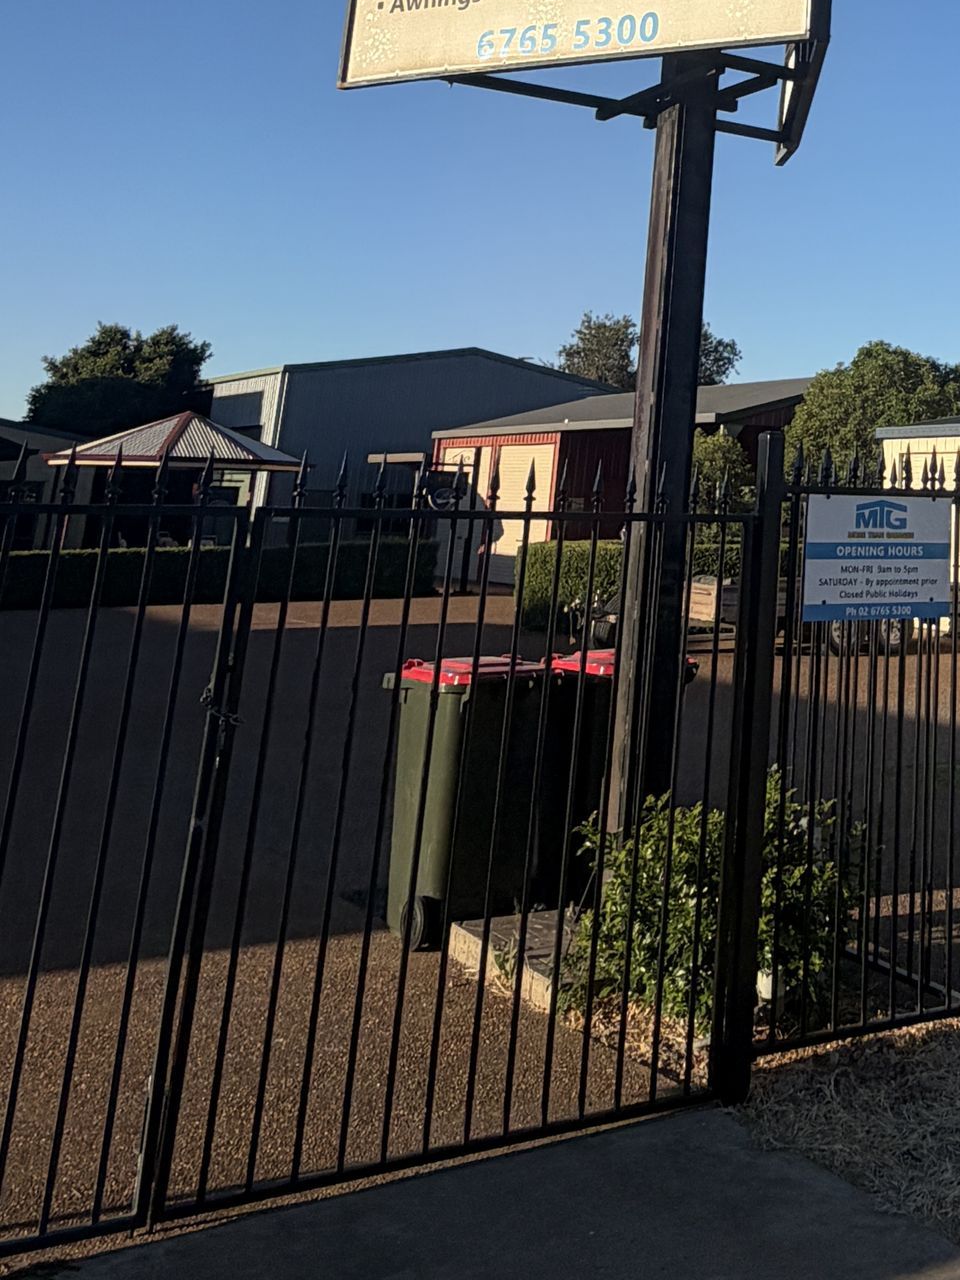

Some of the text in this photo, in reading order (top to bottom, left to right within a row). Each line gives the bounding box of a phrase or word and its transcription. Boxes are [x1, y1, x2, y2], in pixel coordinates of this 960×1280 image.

[477, 12, 660, 60] 6765 5300
[855, 500, 907, 530] MTG
[836, 545, 923, 557] OPENING HOURS
[840, 565, 873, 574] MON-FRI
[894, 565, 902, 573] to
[903, 565, 918, 575] 5pm
[819, 578, 858, 587] SATURDAY
[865, 578, 873, 587] By
[876, 578, 919, 587] appointment
[921, 578, 938, 587] prior
[839, 590, 918, 599] Closed Public Holidays
[846, 607, 857, 616] Ph
[858, 607, 868, 616] 02
[871, 606, 890, 616] 6765
